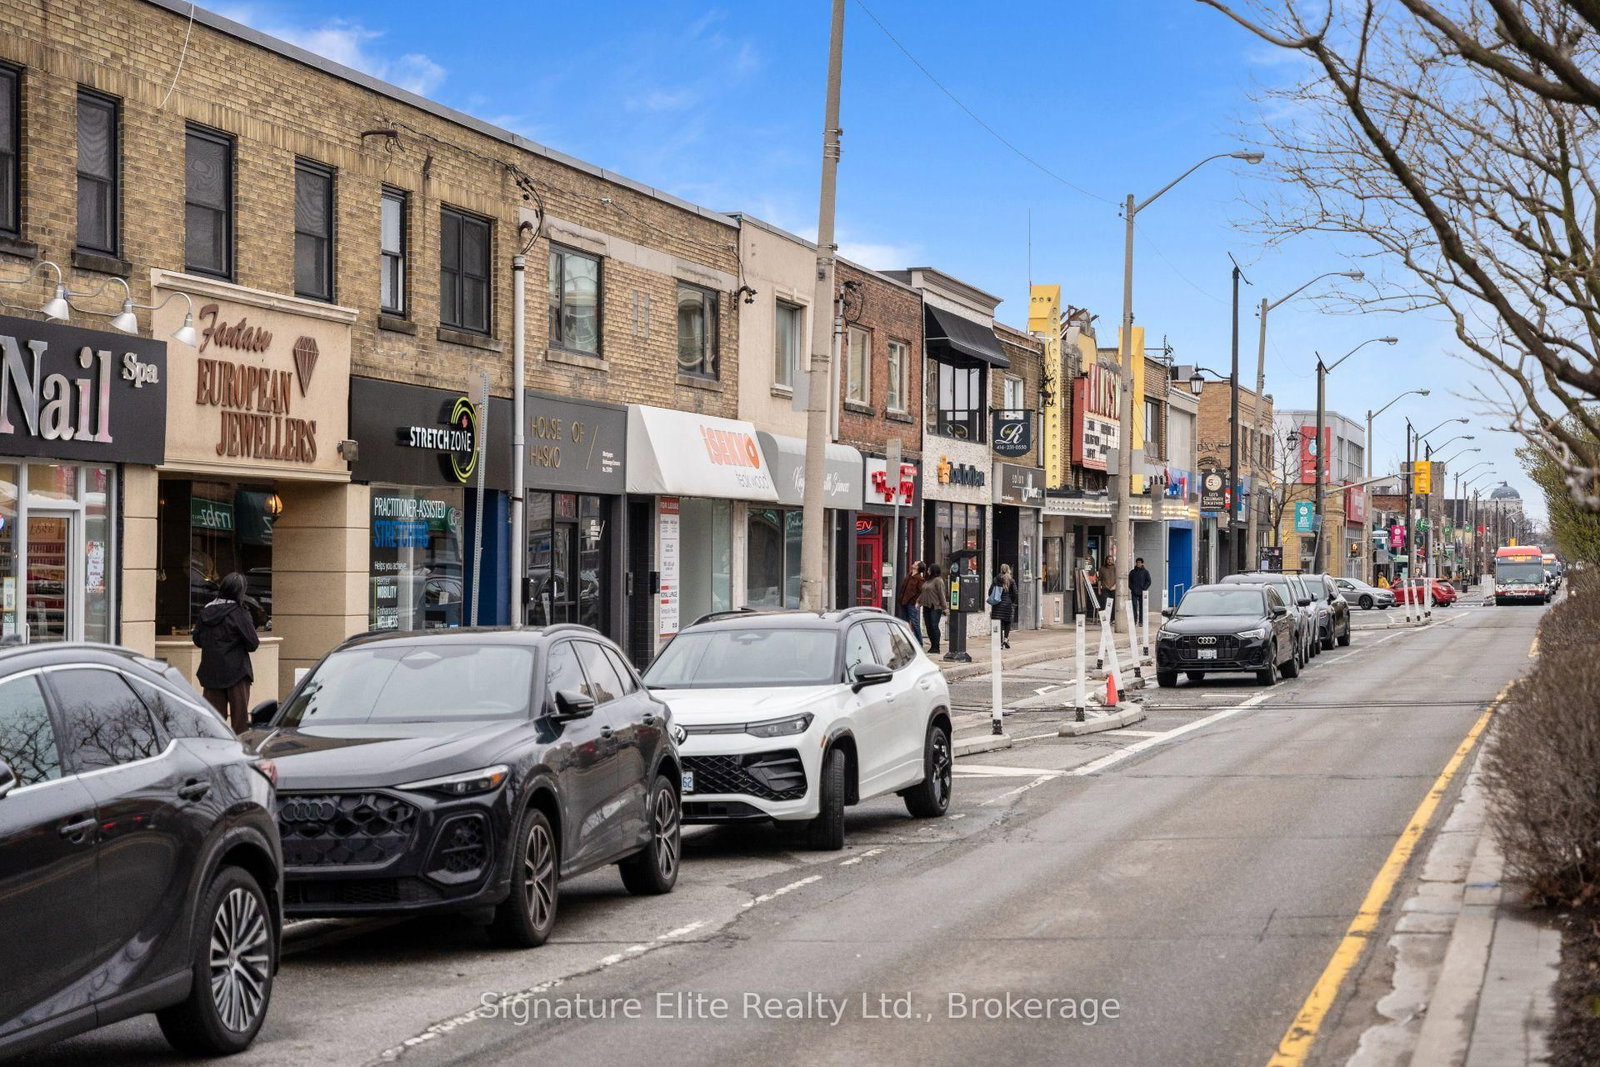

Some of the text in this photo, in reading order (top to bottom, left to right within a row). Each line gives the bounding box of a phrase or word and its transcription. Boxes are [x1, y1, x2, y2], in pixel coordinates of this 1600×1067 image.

[199, 303, 273, 353] Fantasy
[0, 335, 159, 443] Nail Spa
[196, 358, 293, 414] EUROPEAN
[215, 410, 318, 463] JEWELLERS
[409, 426, 472, 452] STRETCH ZONE
[529, 415, 585, 444] HOUSE OF
[528, 444, 561, 469] HASKO
[374, 497, 446, 519] PRACTITIONER-ASSISTED
[855, 520, 873, 531] EN
[374, 561, 386, 572] Helps
[377, 585, 397, 599] MOBILITY
